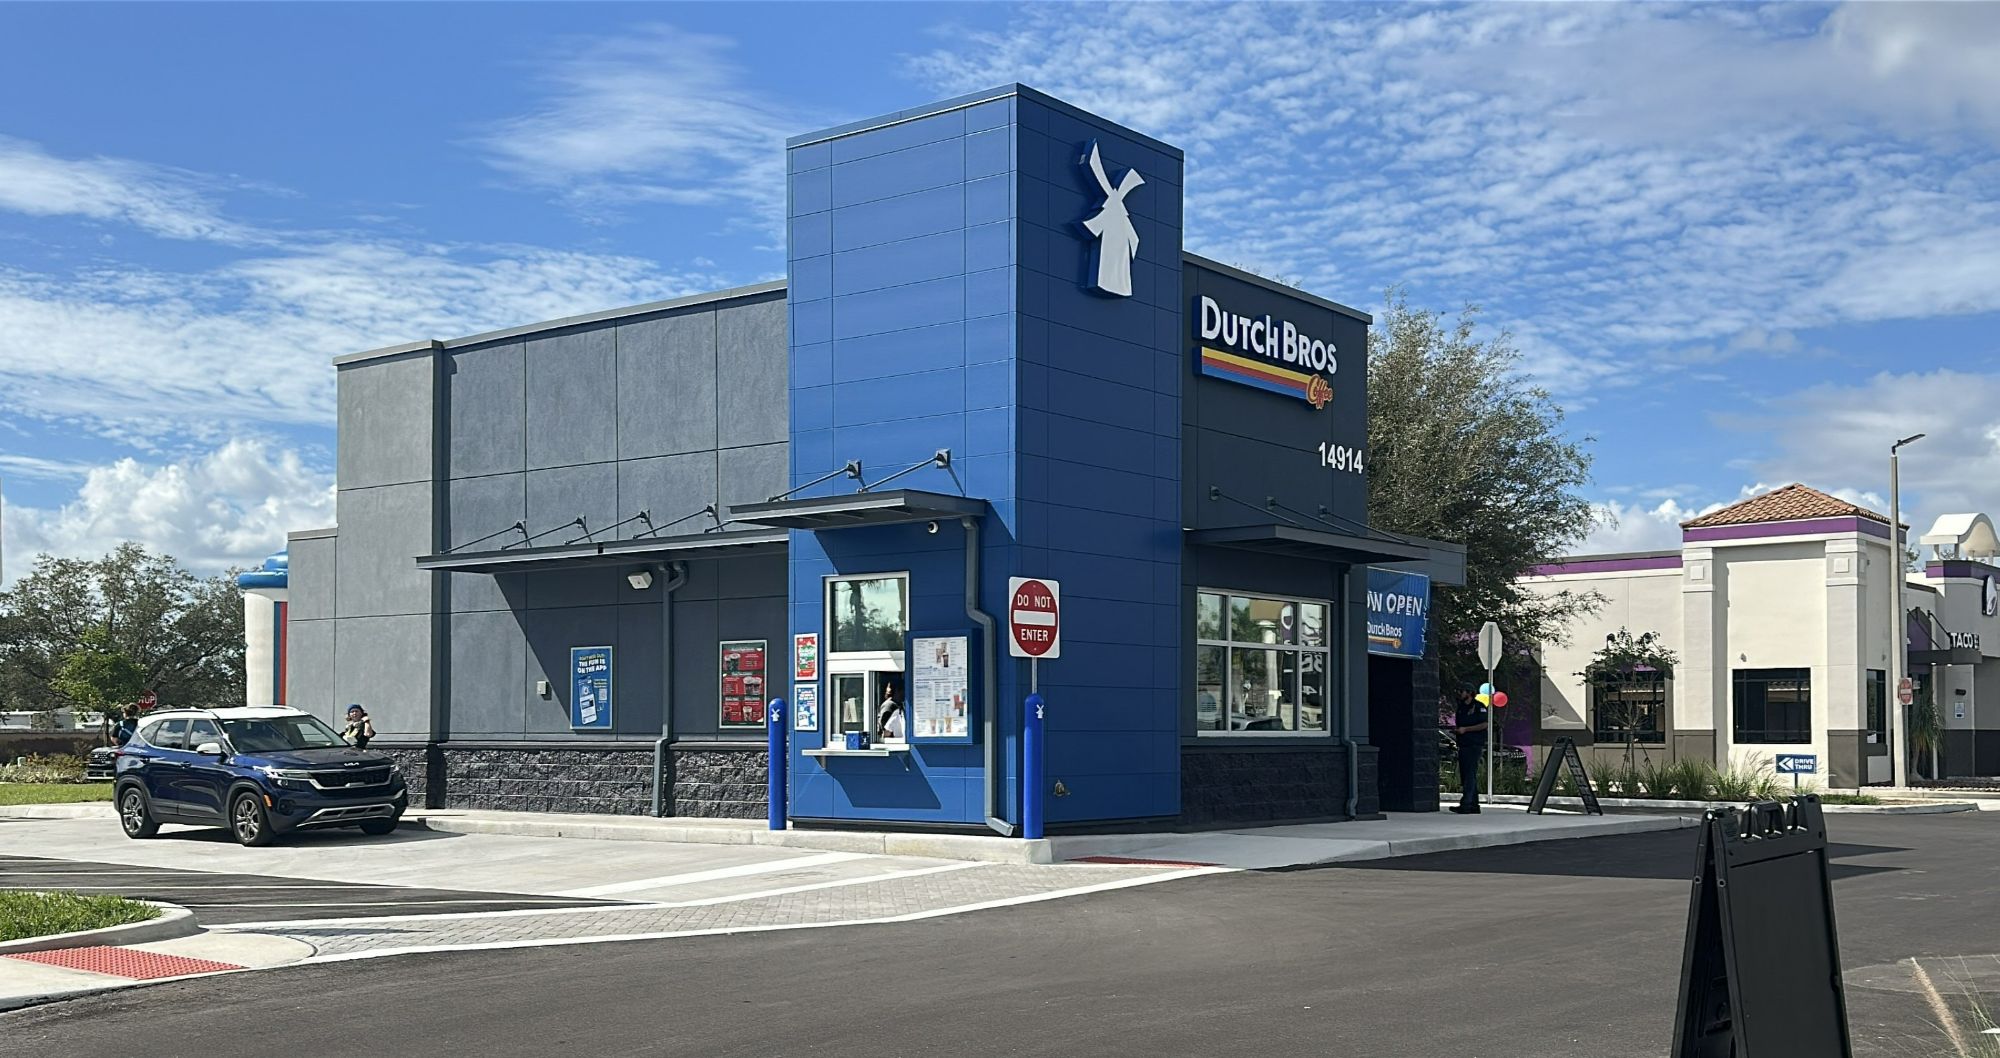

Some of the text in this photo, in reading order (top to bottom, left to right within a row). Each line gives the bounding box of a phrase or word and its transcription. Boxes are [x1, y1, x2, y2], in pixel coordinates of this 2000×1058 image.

[1283, 320, 1337, 374] BROS
[1307, 375, 1333, 409] Coffee
[1318, 441, 1364, 474] 14914
[1017, 594, 1051, 608] DO NOT
[1386, 593, 1423, 616] OPEN
[1021, 628, 1049, 641] ENTER
[1951, 633, 1973, 648] TACO
